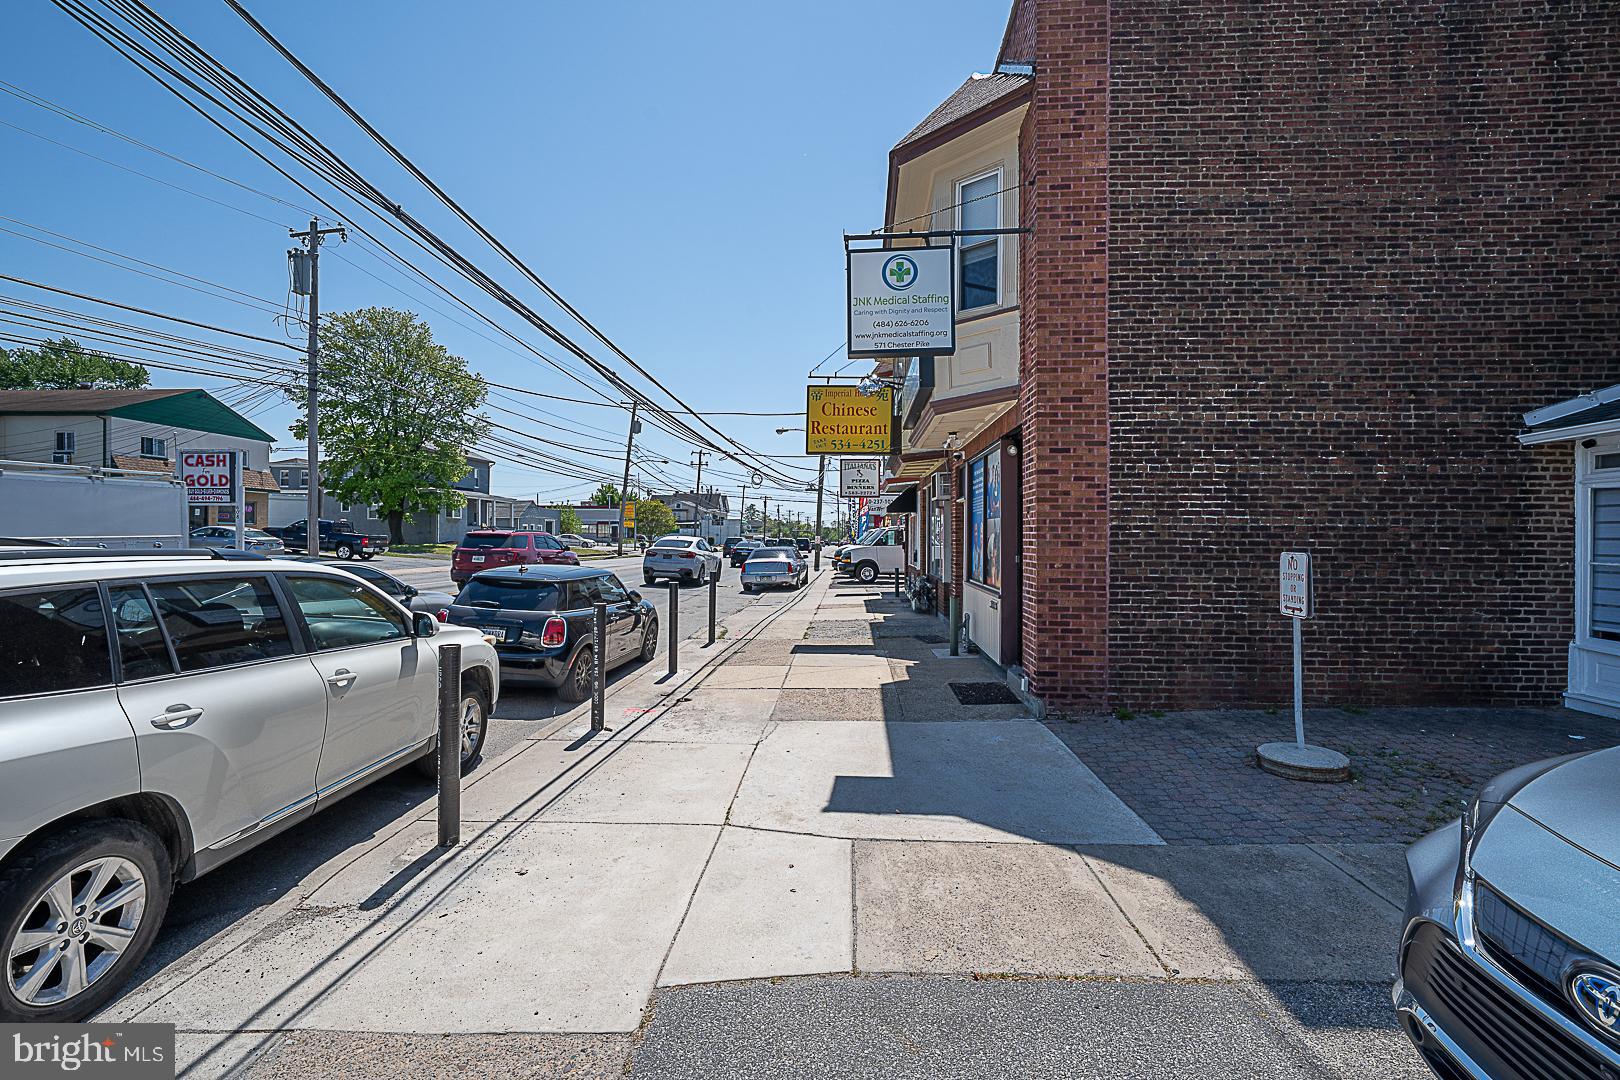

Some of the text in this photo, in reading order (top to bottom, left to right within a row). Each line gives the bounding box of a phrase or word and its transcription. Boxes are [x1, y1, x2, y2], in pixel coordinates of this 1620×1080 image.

[853, 293, 950, 306] JNK Medical Staffing
[853, 309, 874, 317] Caring
[888, 307, 911, 316] Dignity
[923, 306, 948, 314] Respect
[872, 319, 930, 329] (484) 626-6206
[854, 330, 948, 340] www.jnkmedicalstaffing.org
[887, 341, 915, 349] Chester
[825, 389, 851, 399] Imperial
[821, 402, 878, 417] Chinese
[810, 420, 889, 435] Restaurant
[830, 438, 885, 450] 534-4251
[184, 454, 227, 467] CASH
[184, 474, 229, 487] GOLD
[1287, 559, 1298, 571] NO
[1282, 572, 1305, 583] STOPPING
[1290, 584, 1297, 593] OR
[1283, 594, 1305, 605] STANDING
